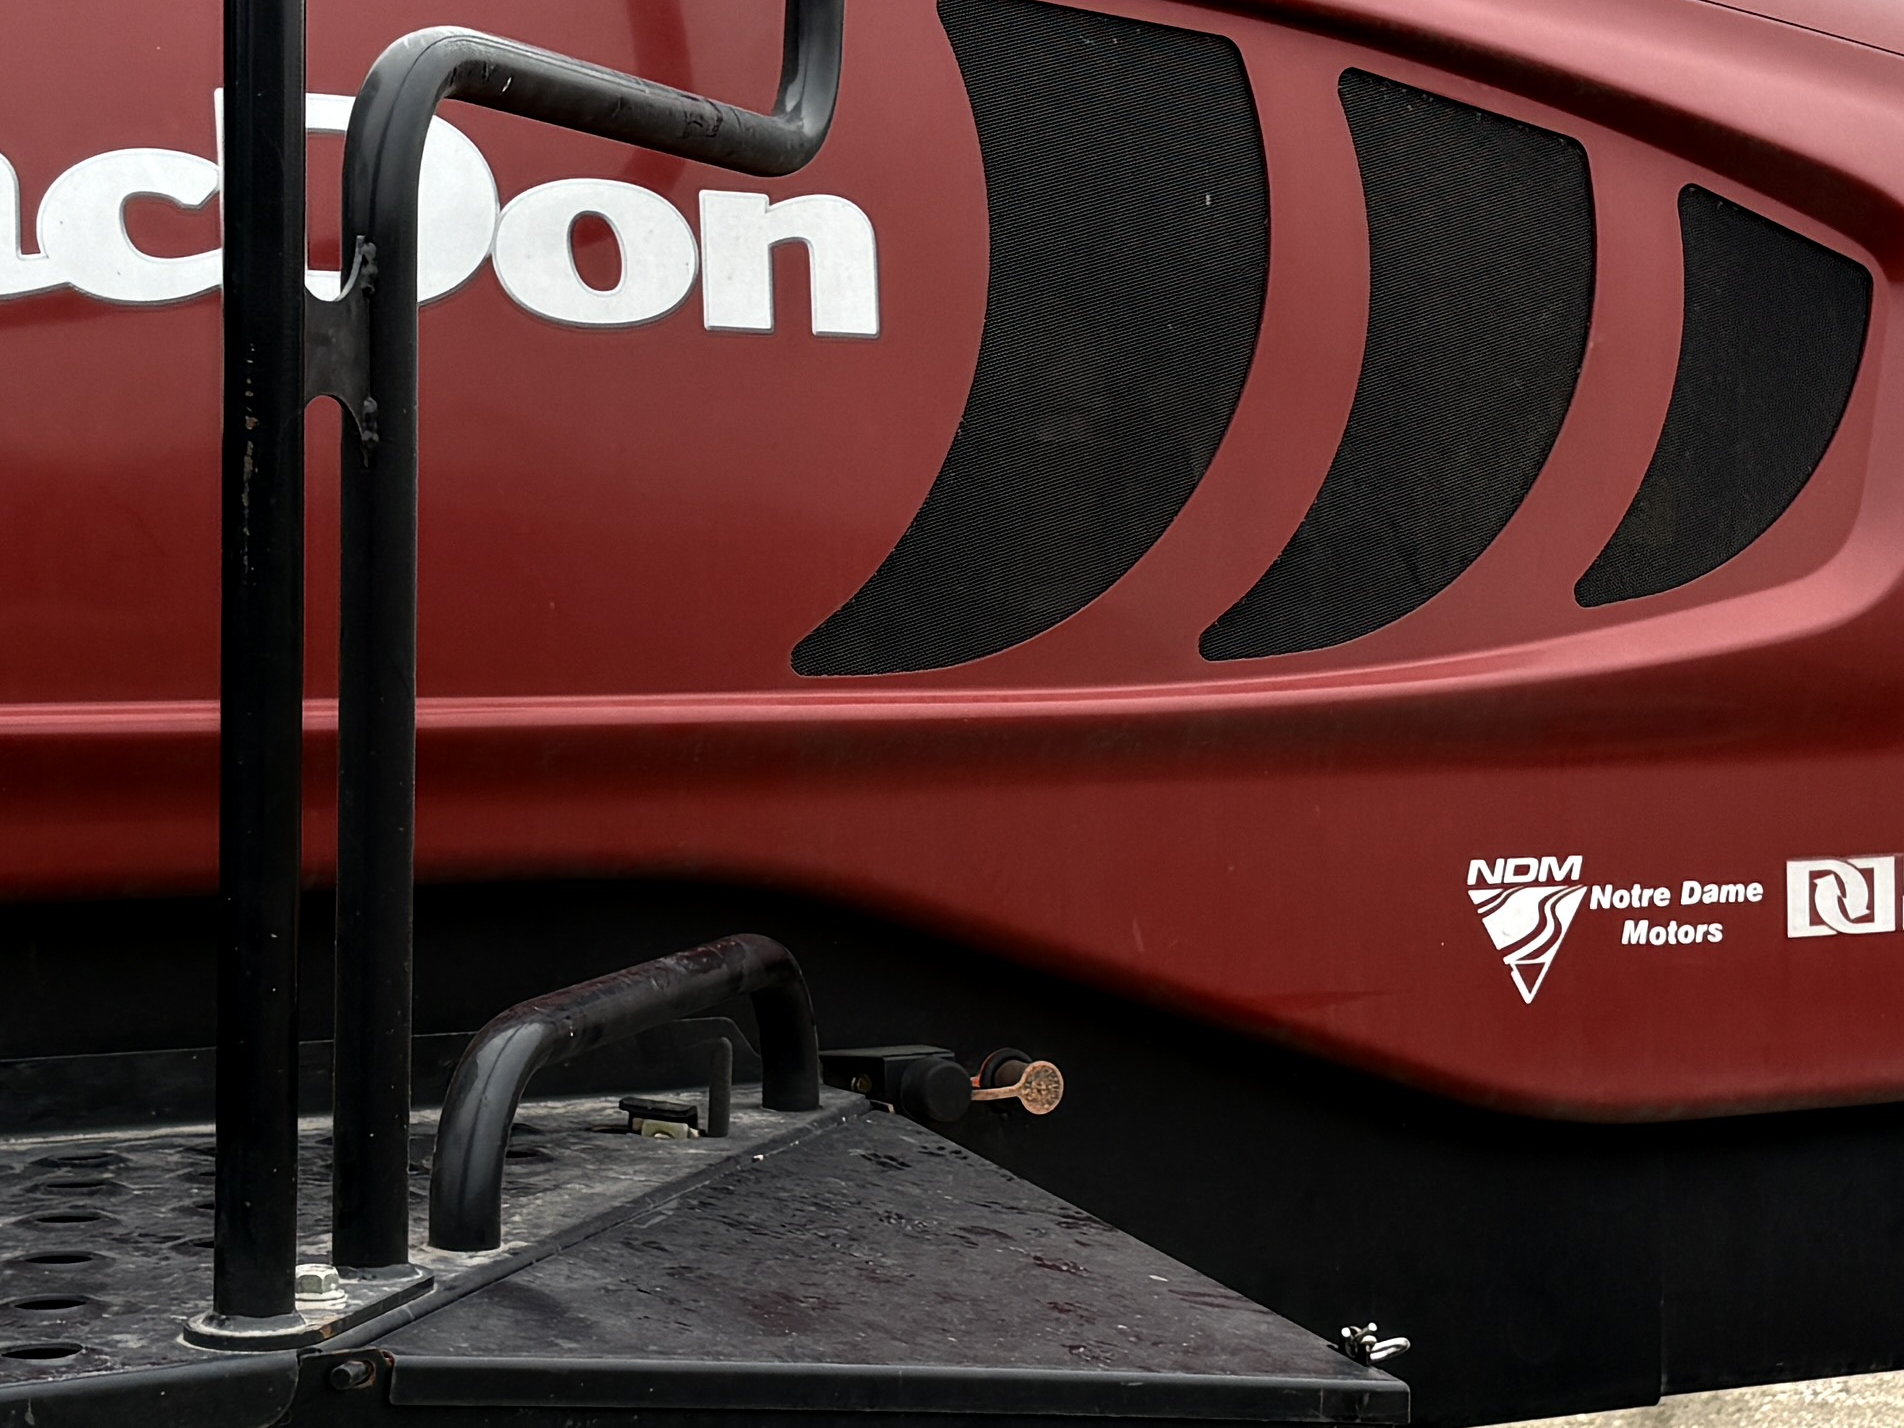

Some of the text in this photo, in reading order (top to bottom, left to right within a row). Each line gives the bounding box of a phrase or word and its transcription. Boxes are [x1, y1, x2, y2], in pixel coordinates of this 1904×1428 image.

[1467, 855, 1583, 885] NDM
[1589, 880, 1764, 910] Notre Dame
[1621, 919, 1724, 946] Motors
